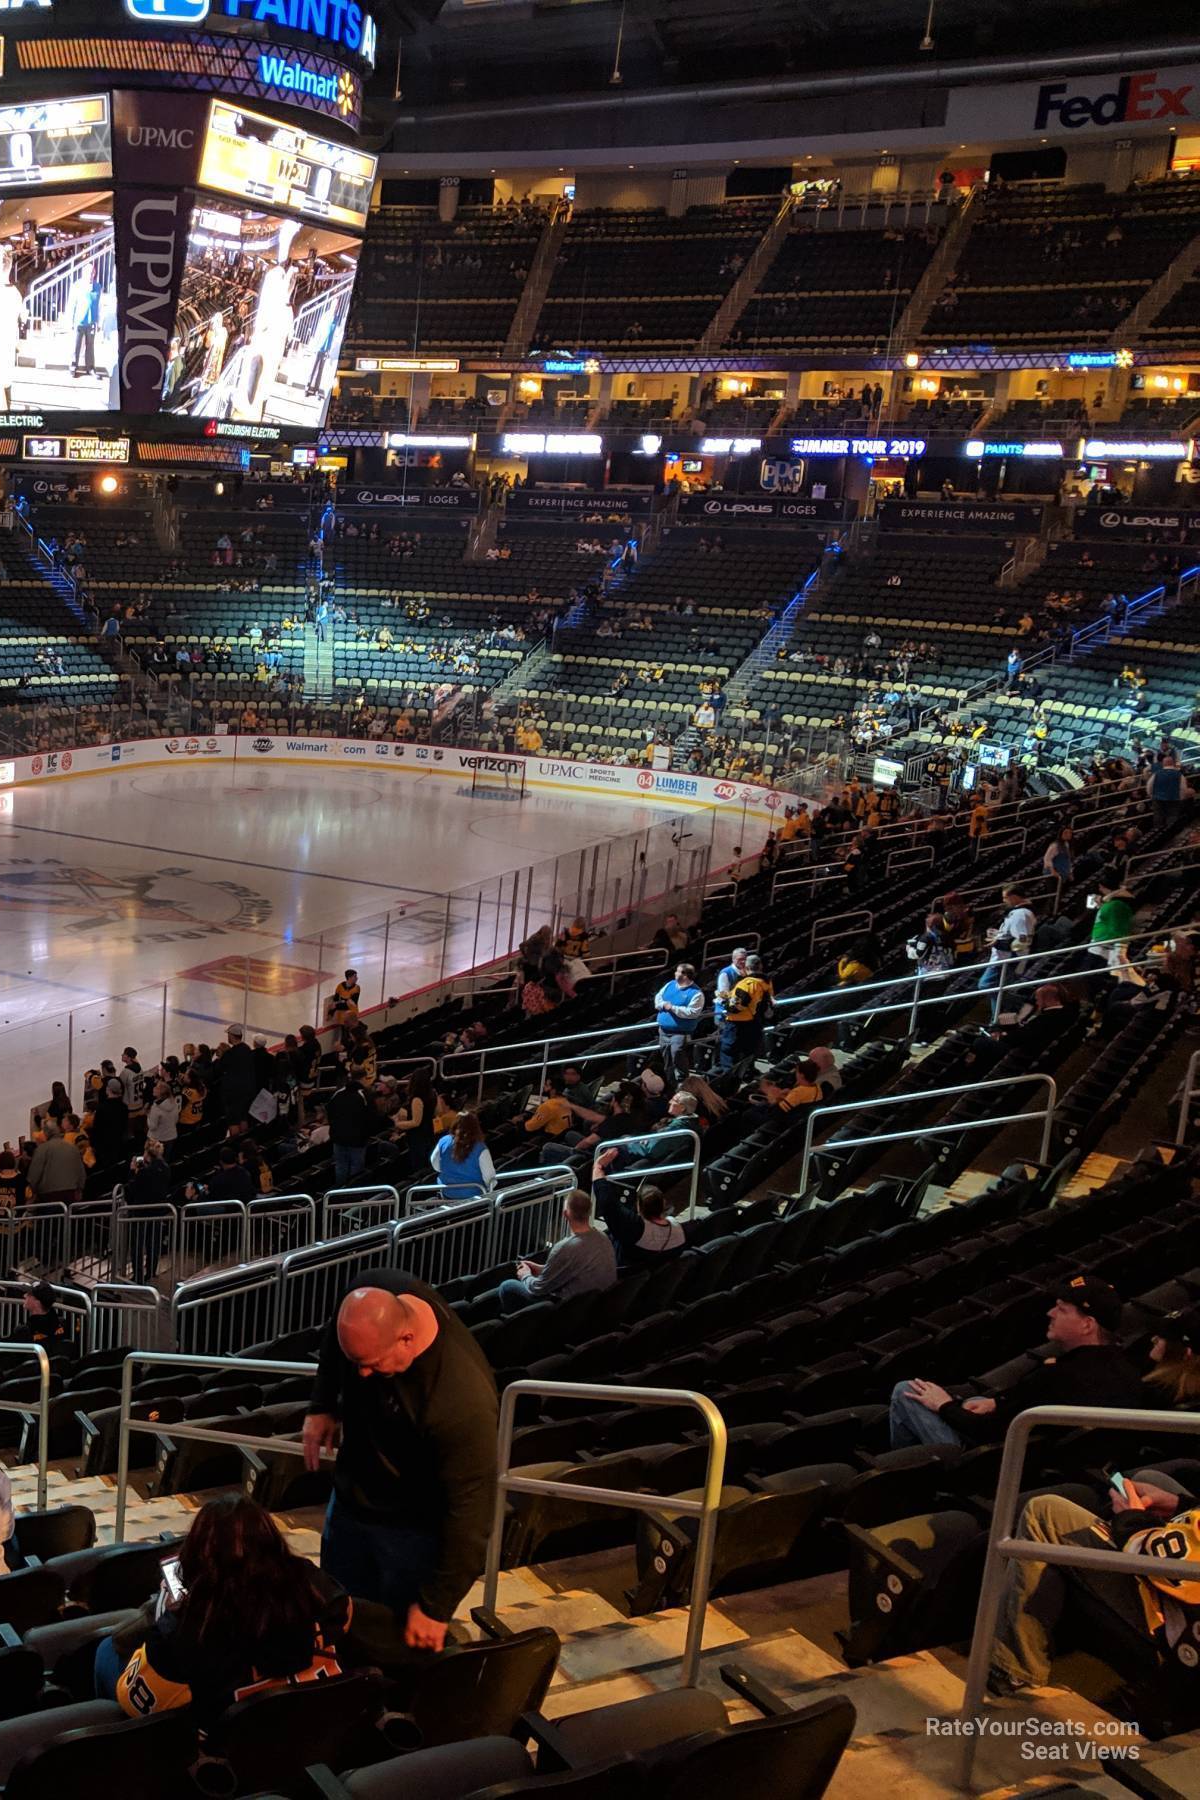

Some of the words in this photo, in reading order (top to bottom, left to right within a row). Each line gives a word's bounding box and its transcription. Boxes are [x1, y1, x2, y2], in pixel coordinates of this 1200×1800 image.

[260, 56, 339, 102] Walmart
[1034, 72, 1195, 131] FedEx
[127, 126, 195, 149] UPMC
[440, 177, 460, 187] 209
[119, 195, 179, 392] UPMC
[545, 360, 585, 372] Walmart
[1070, 354, 1116, 366] Walmart
[216, 423, 252, 437] MITSUBISHI
[252, 427, 281, 439] ELECTRIC
[30, 439, 61, 457] 1:21
[70, 438, 128, 450] COUNTDOWN
[792, 439, 850, 454] SUMMER
[851, 439, 888, 455] TOUR
[889, 440, 927, 456] 2019
[985, 443, 1024, 455] PAINTS
[80, 448, 127, 461] WARMUPS
[375, 494, 421, 503] LEXUS
[428, 495, 460, 504] LOGES
[528, 498, 585, 508] EXPERIENCE
[586, 499, 628, 509] AMAZING
[723, 504, 773, 513] LEXUS
[783, 505, 817, 515] LOGES
[901, 508, 965, 520] EXPERIENCE
[968, 511, 1015, 521] AMAZING
[1123, 516, 1179, 526] LEXUS
[286, 741, 328, 753] Walmart
[344, 745, 366, 755] com
[459, 755, 518, 774] verizon
[538, 762, 584, 779] UPMC
[588, 774, 621, 784] MEDICINE
[589, 768, 616, 777] SPORTS
[638, 774, 653, 787] 84
[656, 776, 698, 794] LUMBER
[719, 785, 733, 797] DQ
